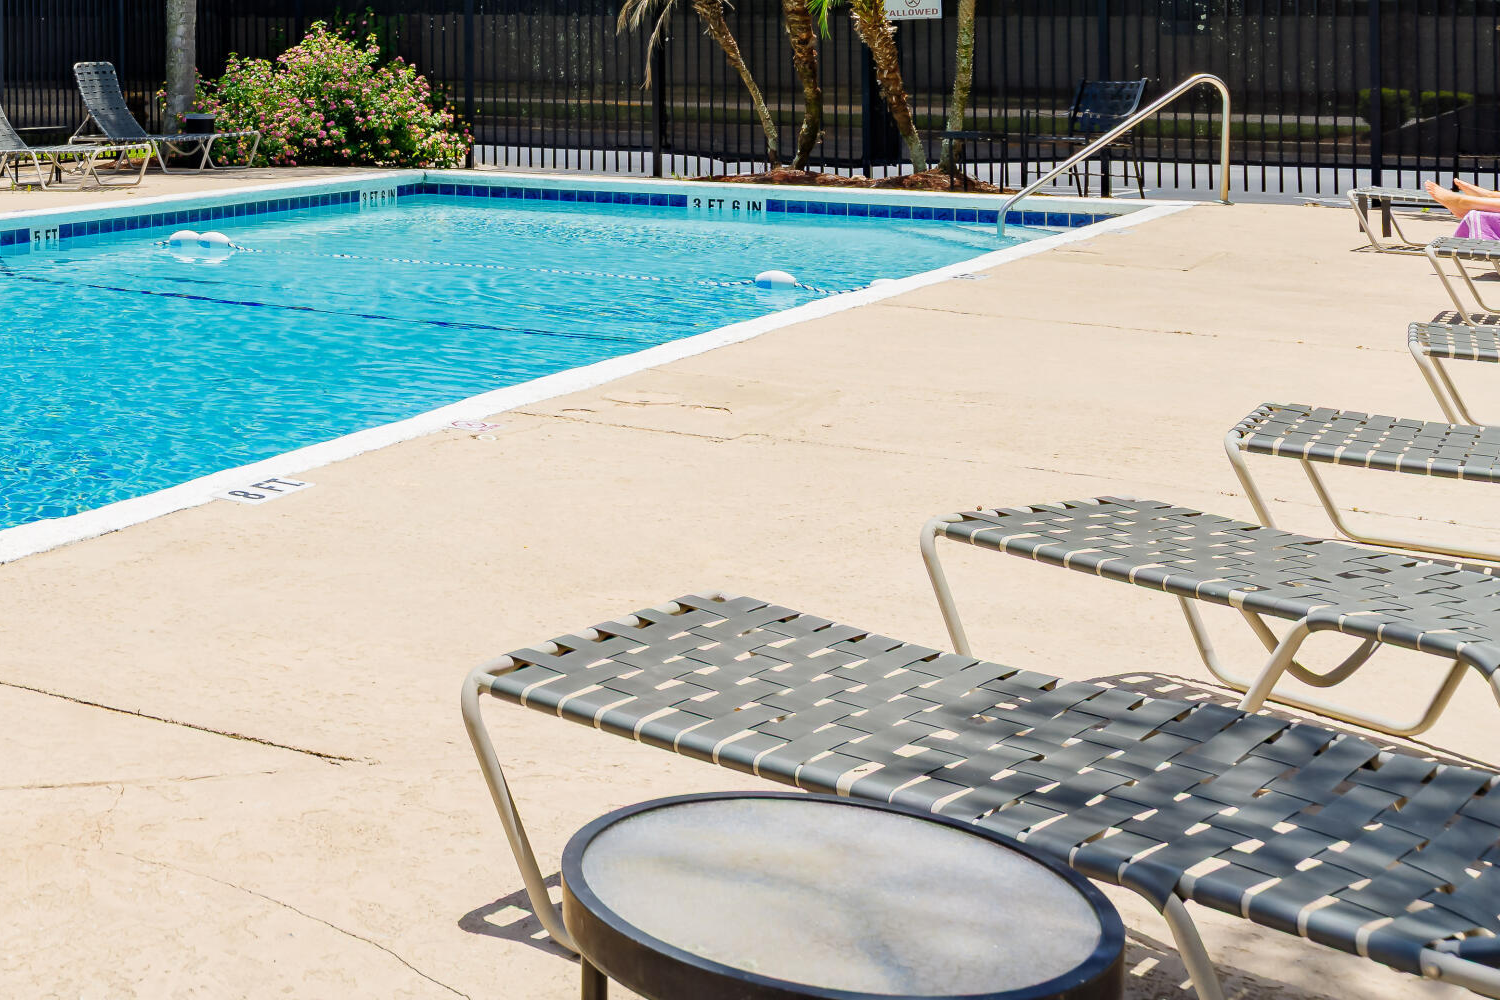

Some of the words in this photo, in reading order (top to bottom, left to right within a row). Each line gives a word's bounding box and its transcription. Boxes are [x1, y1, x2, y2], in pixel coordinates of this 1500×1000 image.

[889, 8, 938, 16] ALLOWED
[708, 199, 724, 208] FT
[747, 200, 761, 210] IN
[34, 231, 40, 241] 5
[45, 229, 57, 240] FT
